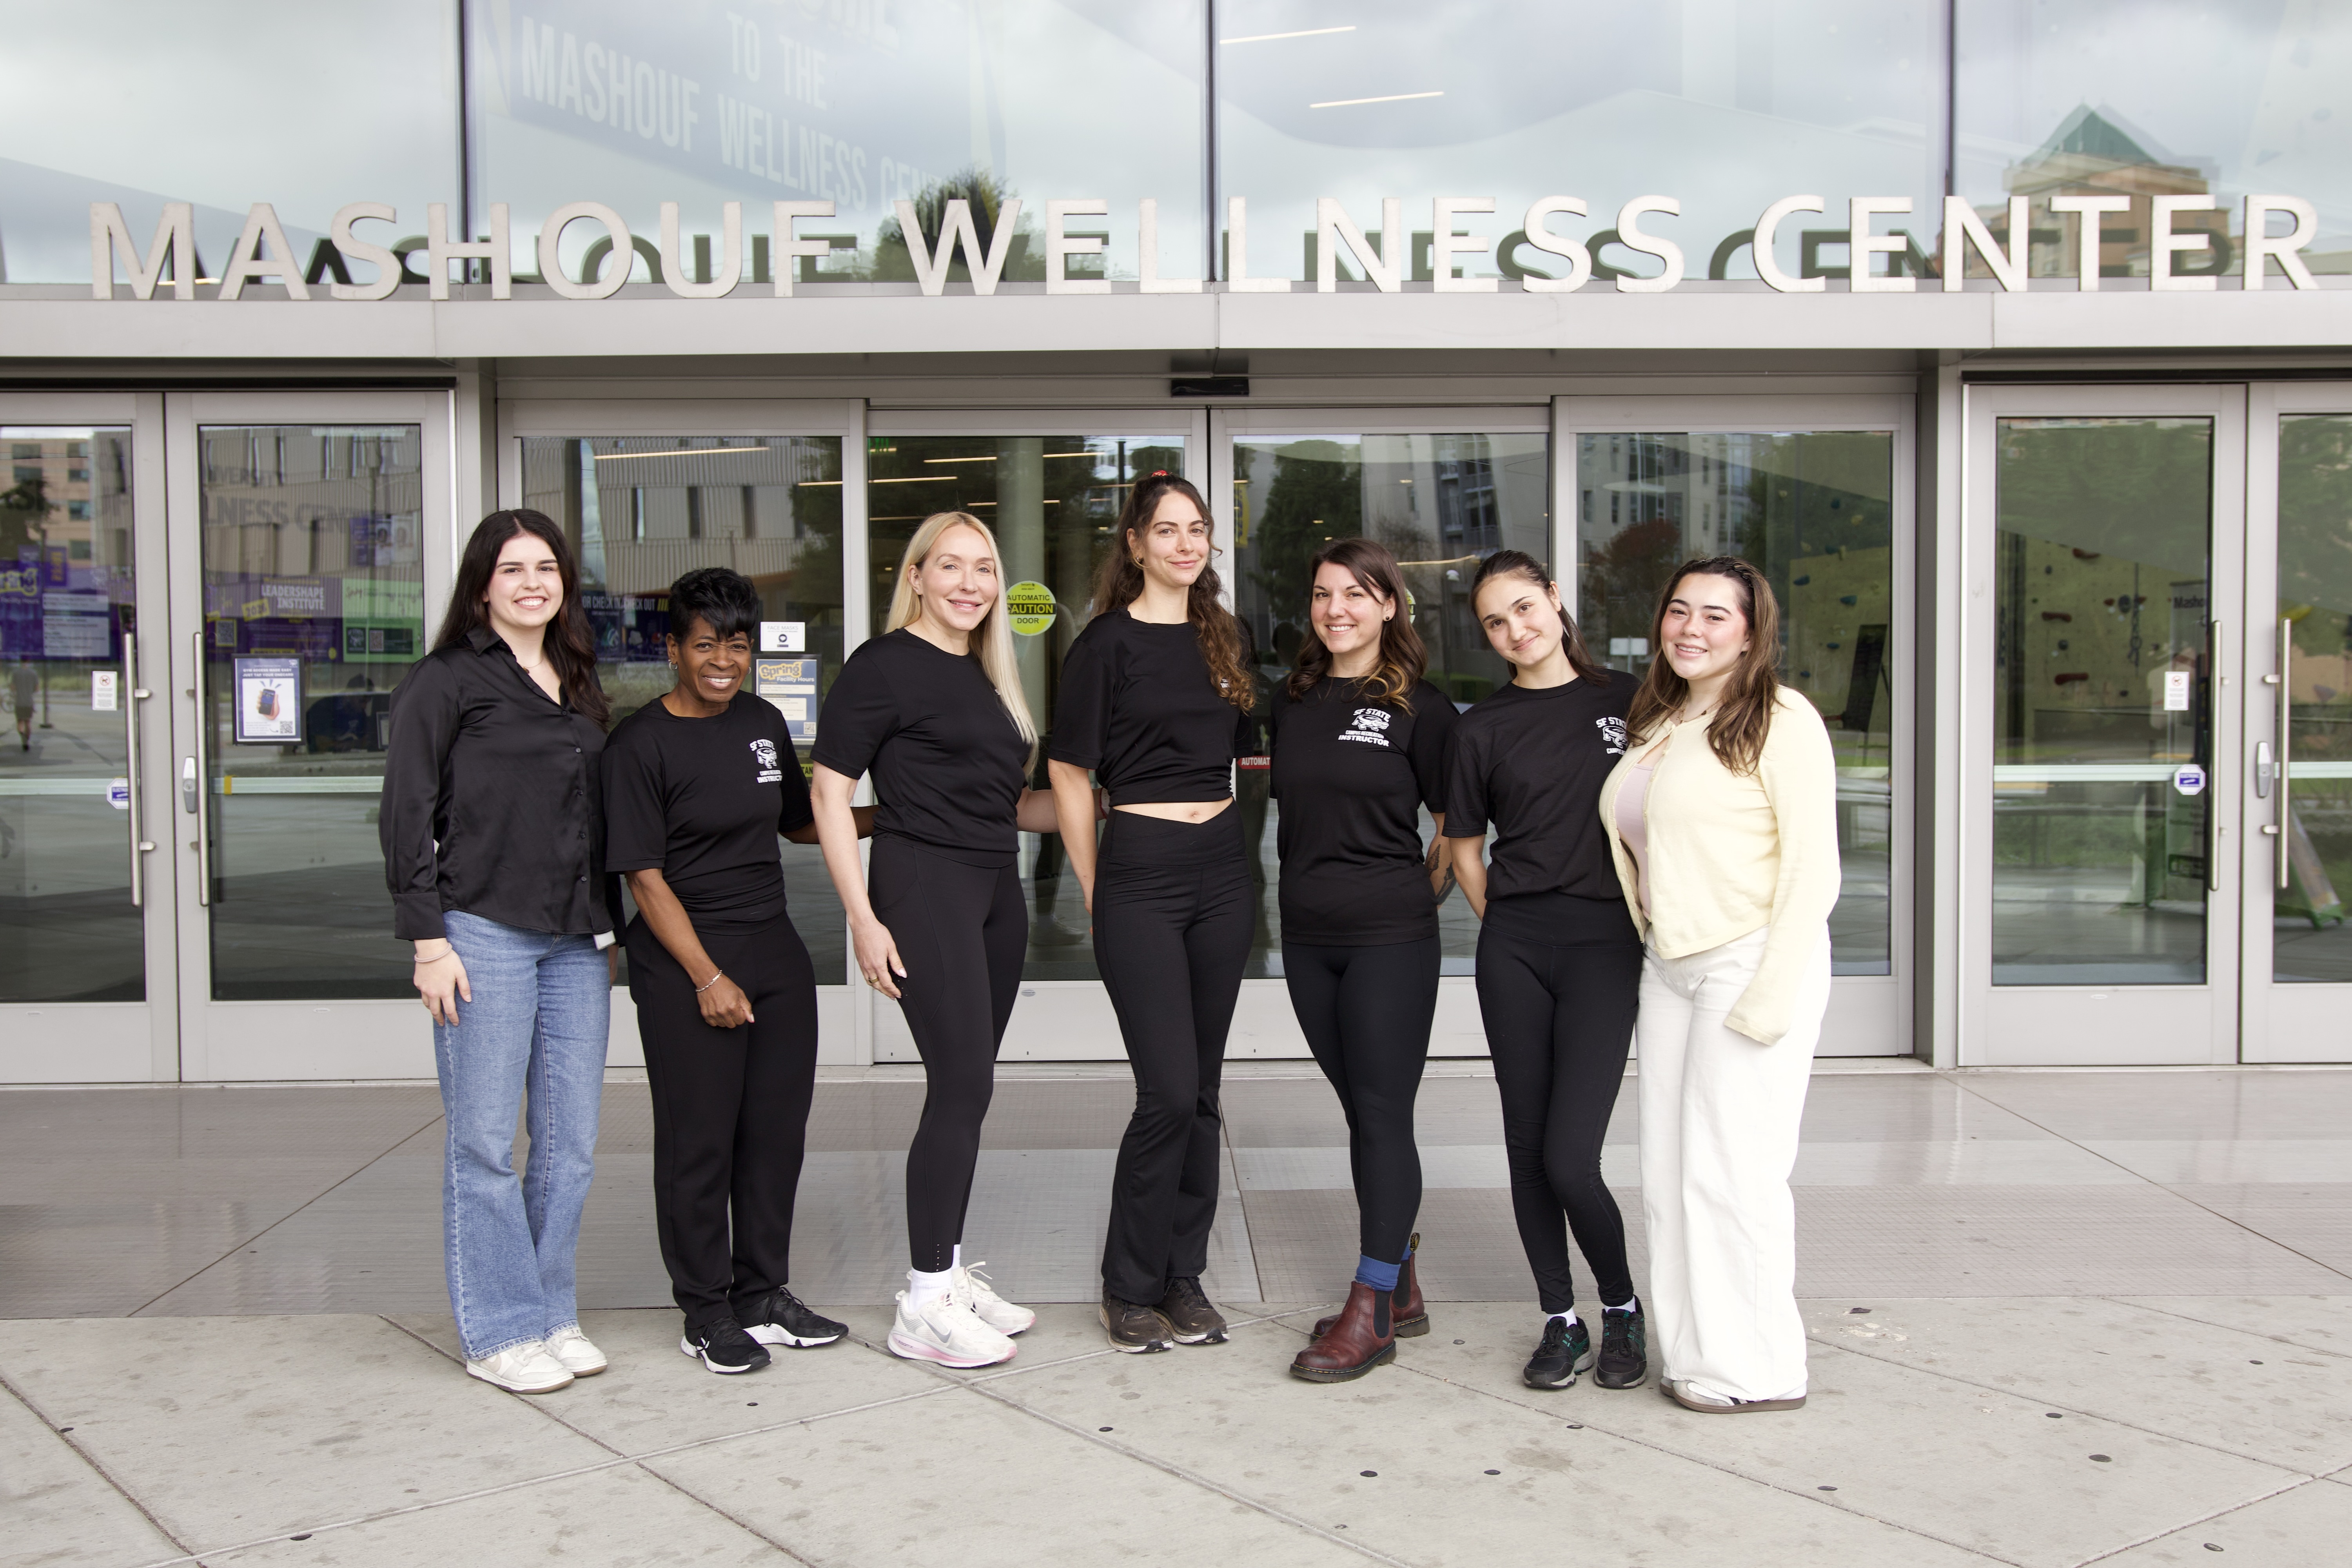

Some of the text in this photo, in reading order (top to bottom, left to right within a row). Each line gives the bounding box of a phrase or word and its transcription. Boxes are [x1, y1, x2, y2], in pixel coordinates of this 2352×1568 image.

[726, 11, 760, 83] TO
[778, 34, 827, 111] THE
[521, 15, 700, 152] MASHOUF
[717, 93, 867, 212] WELLNESS
[89, 194, 2319, 300] MASHOUF WELLNESS CENTER
[261, 584, 325, 599] LEADERSHAPE
[277, 597, 325, 610] INSTITUTE
[643, 598, 655, 611] OUT
[760, 663, 800, 678] Spring
[1365, 708, 1391, 722] STATE
[1338, 735, 1390, 747] INSTRUCTOR
